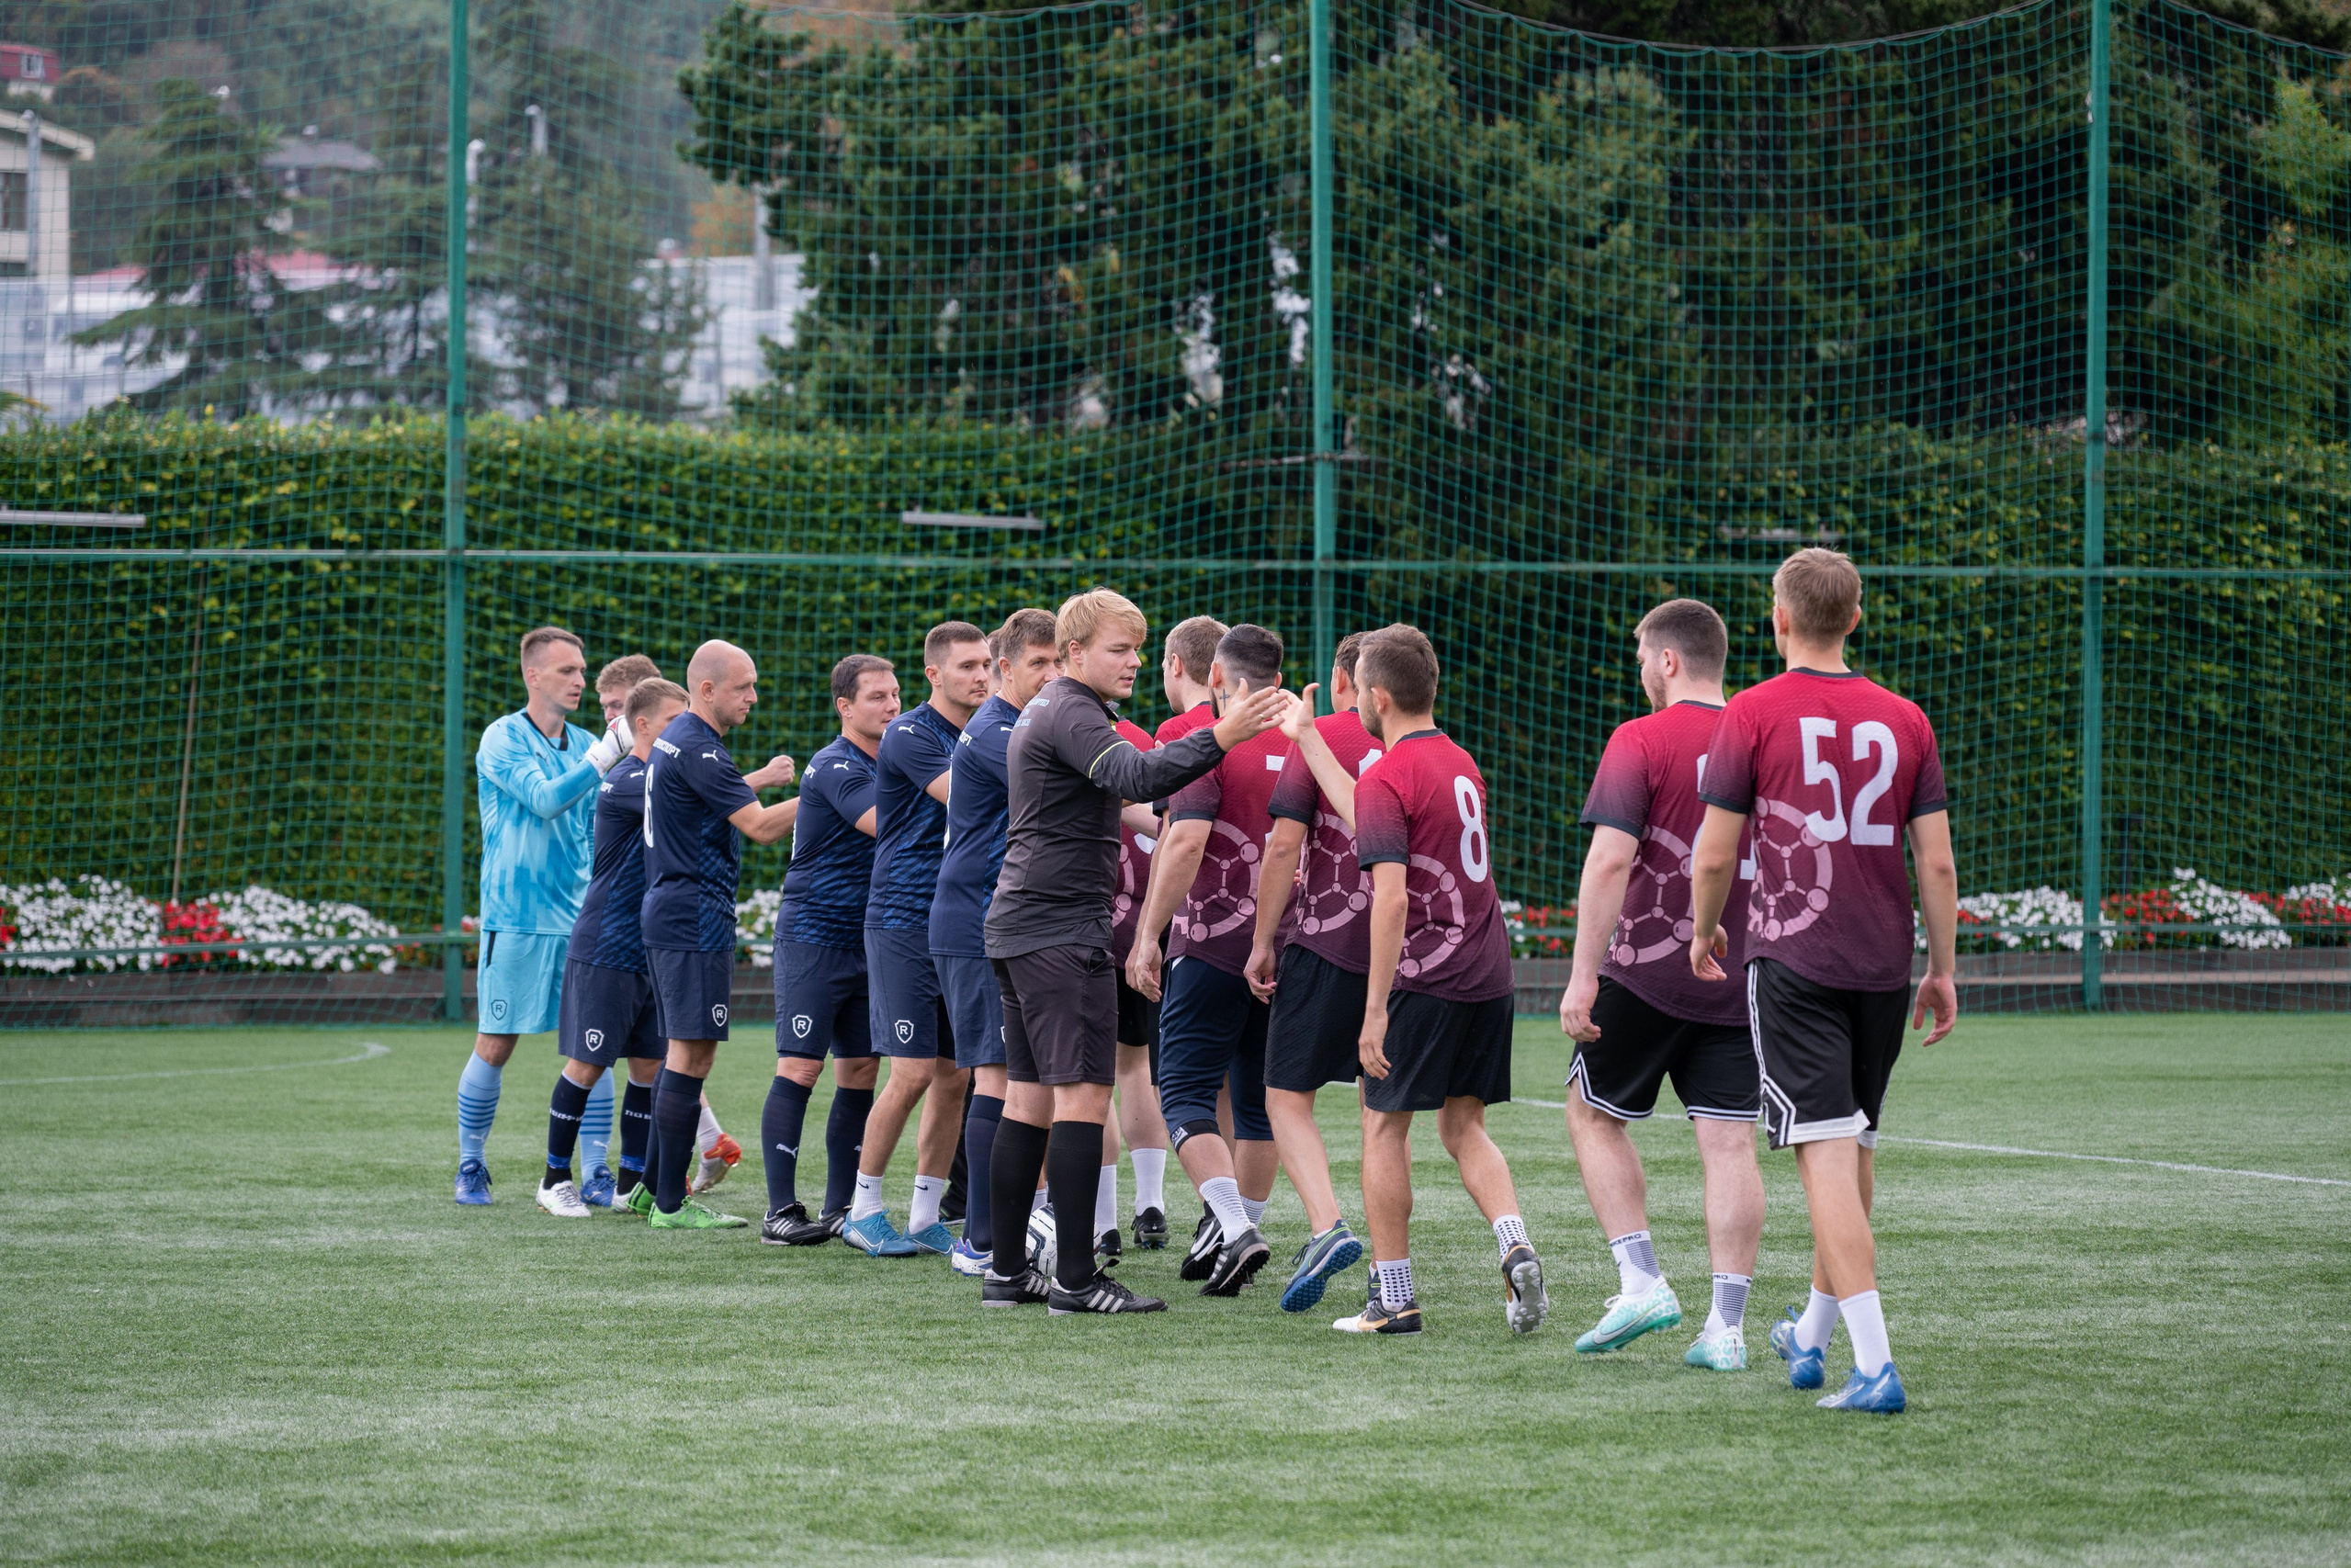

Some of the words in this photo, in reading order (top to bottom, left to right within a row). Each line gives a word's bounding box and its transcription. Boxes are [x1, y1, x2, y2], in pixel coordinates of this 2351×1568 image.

[644, 763, 654, 848] 6
[1453, 775, 1488, 883] 8
[1799, 716, 1898, 846] 52
